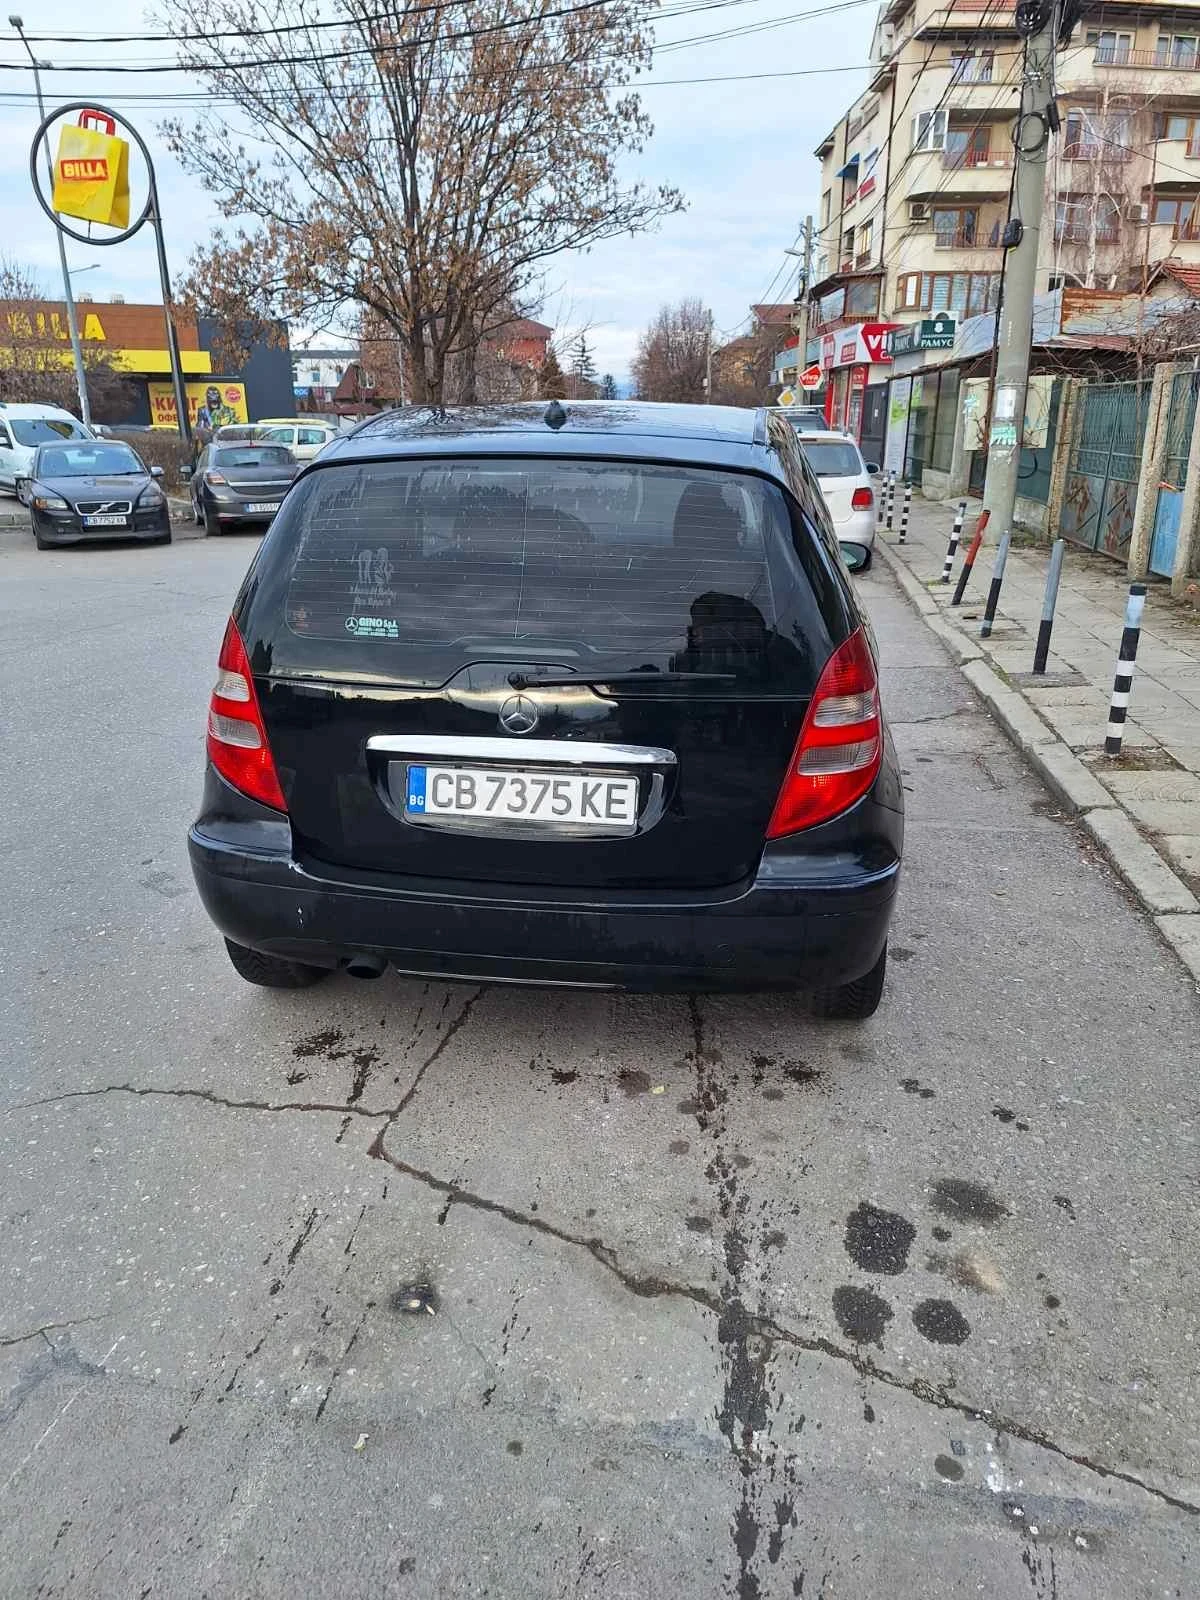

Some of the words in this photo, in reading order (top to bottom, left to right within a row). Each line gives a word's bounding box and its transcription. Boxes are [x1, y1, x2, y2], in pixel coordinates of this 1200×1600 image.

[63, 161, 106, 177] BILLA
[867, 330, 888, 350] vi
[920, 338, 954, 348] РАМУС
[155, 396, 198, 411] КИГ
[409, 794, 424, 806] BG
[431, 773, 477, 810] CB
[485, 775, 572, 815] 7375
[580, 782, 629, 820] KE
